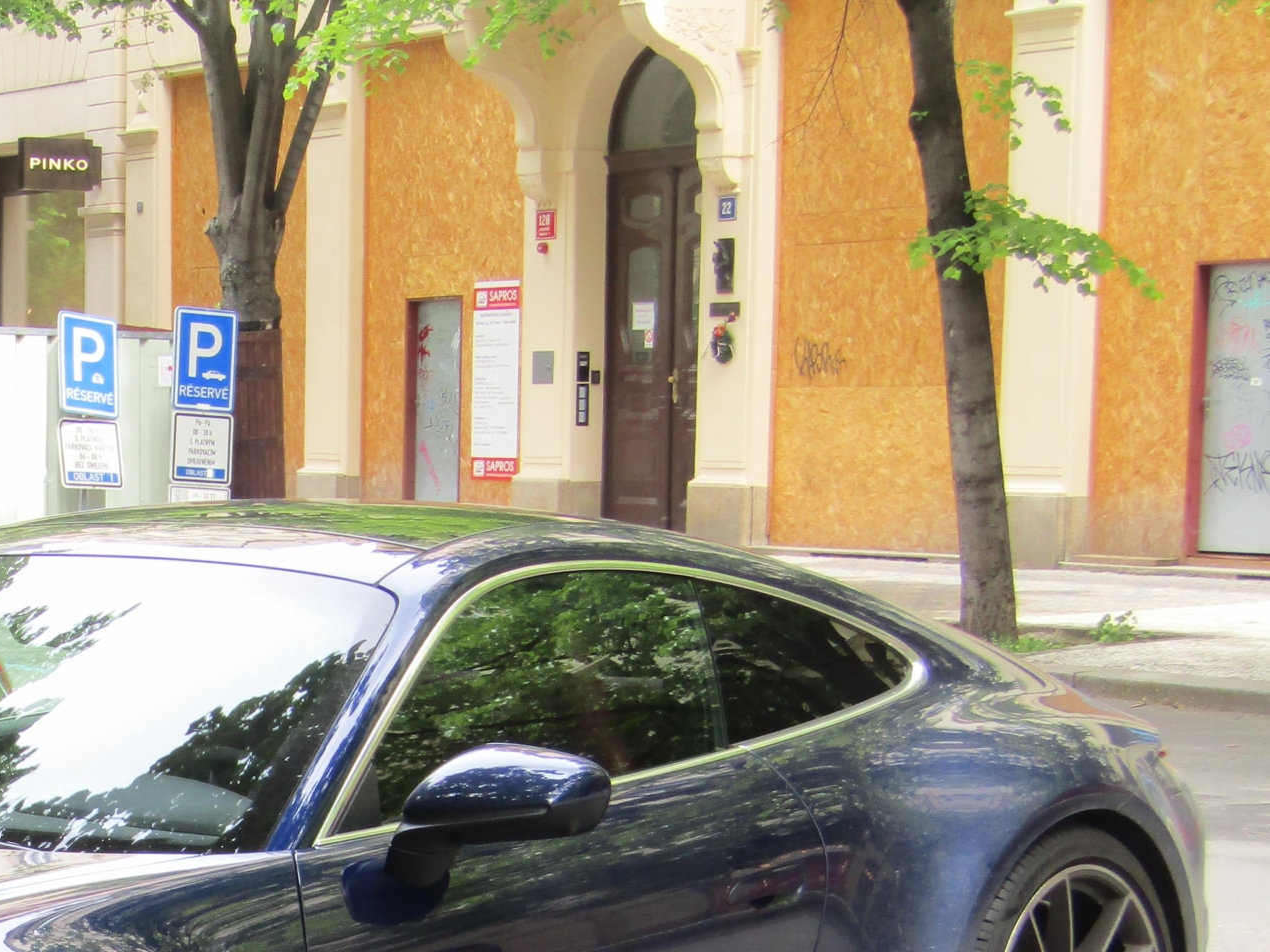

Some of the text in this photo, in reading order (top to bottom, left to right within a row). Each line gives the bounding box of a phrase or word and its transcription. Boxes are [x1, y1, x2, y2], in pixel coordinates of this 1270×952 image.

[29, 157, 89, 172] PINKO
[721, 201, 732, 215] 22
[538, 214, 551, 226] 128
[489, 289, 517, 302] SAPROS
[72, 326, 105, 382] P
[188, 322, 223, 378] P
[66, 386, 114, 406] RÉSERVÉ
[179, 384, 229, 400] RÉSERVÉ
[485, 460, 515, 472] SAPROS
[73, 472, 105, 482] OBLAST
